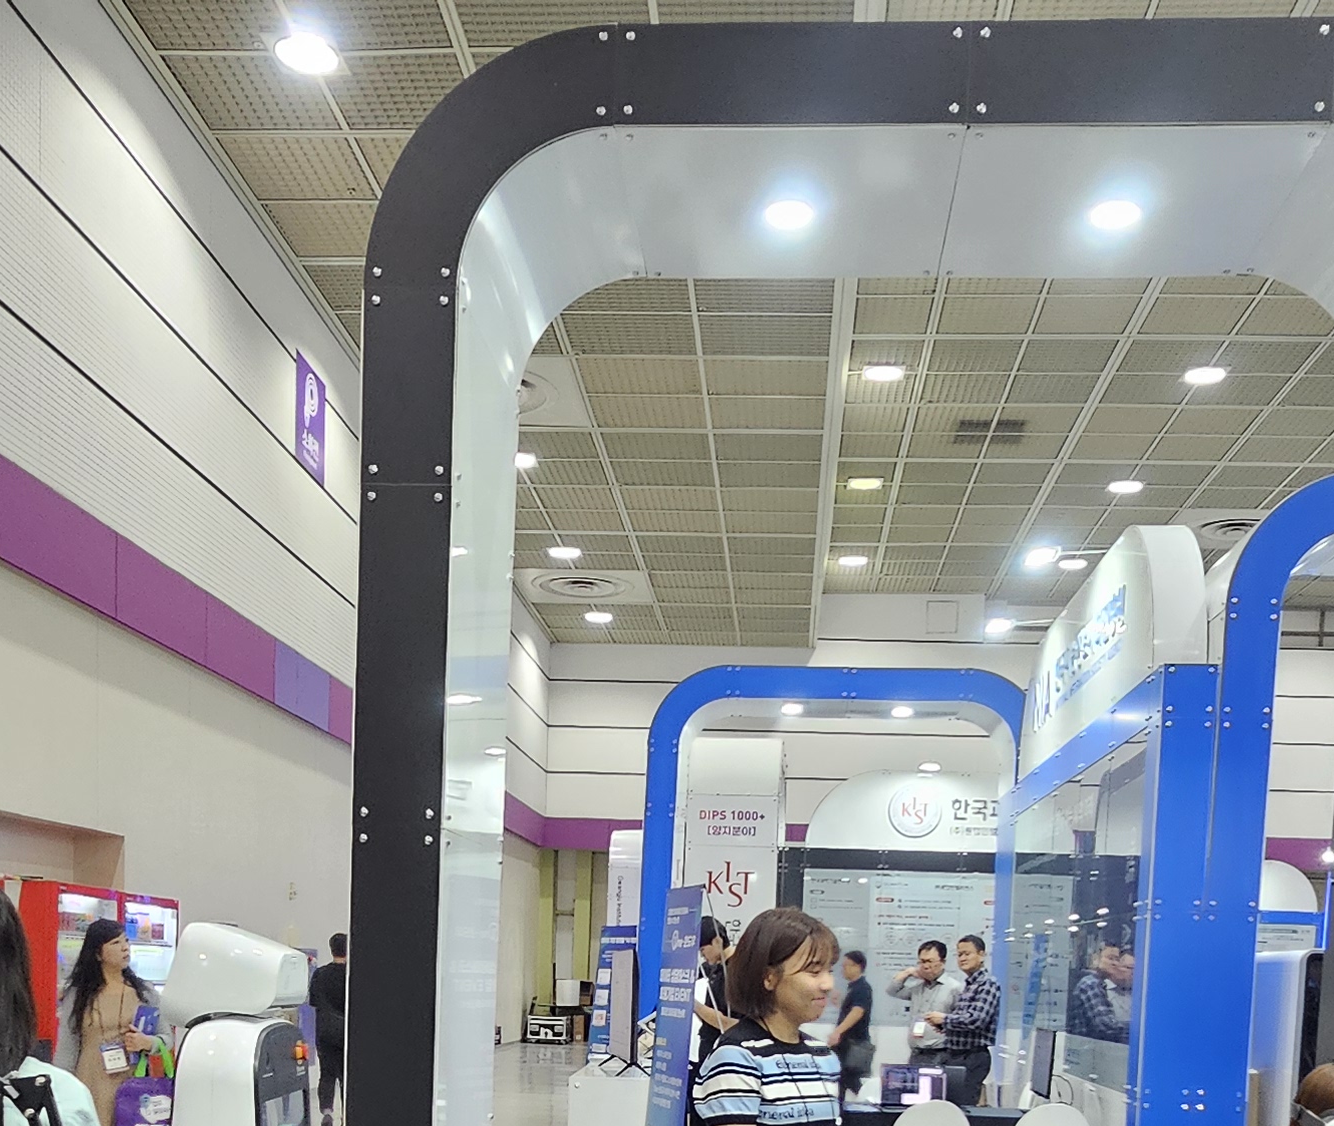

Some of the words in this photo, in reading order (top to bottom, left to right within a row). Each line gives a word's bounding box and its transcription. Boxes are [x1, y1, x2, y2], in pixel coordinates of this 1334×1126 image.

[699, 810, 726, 821] DIPS
[730, 810, 766, 822] 1000+
[901, 797, 928, 825] KIST
[706, 860, 755, 908] KIST
